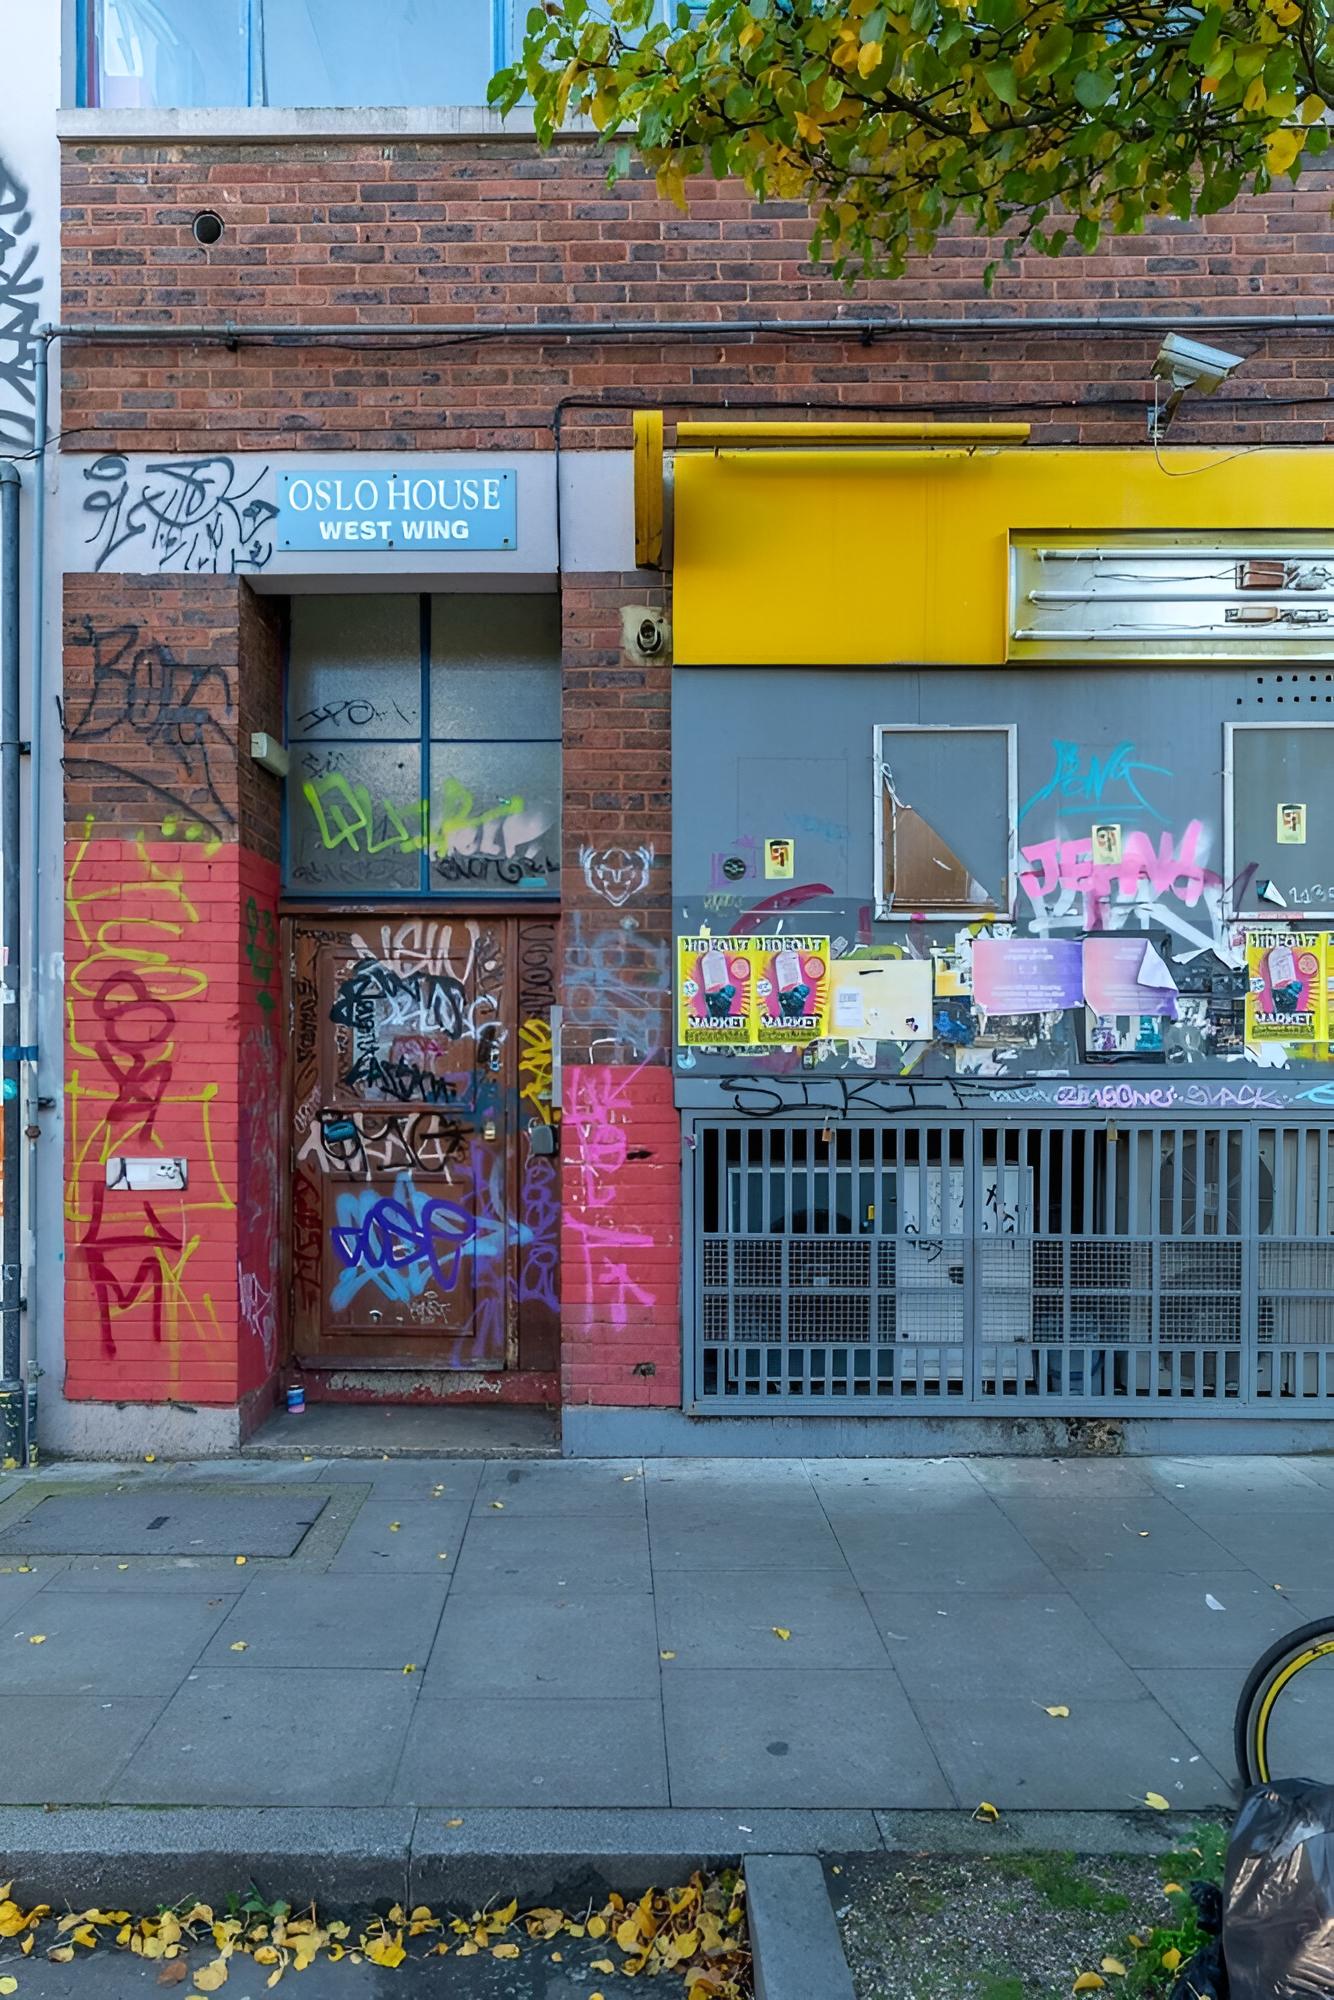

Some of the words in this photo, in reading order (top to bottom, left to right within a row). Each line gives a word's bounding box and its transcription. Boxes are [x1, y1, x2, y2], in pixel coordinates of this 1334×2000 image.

[289, 479, 379, 511] OSLO
[387, 478, 501, 511] HOUSE
[319, 520, 392, 540] WEST
[402, 519, 469, 540] WING
[688, 1016, 747, 1028] MARKET
